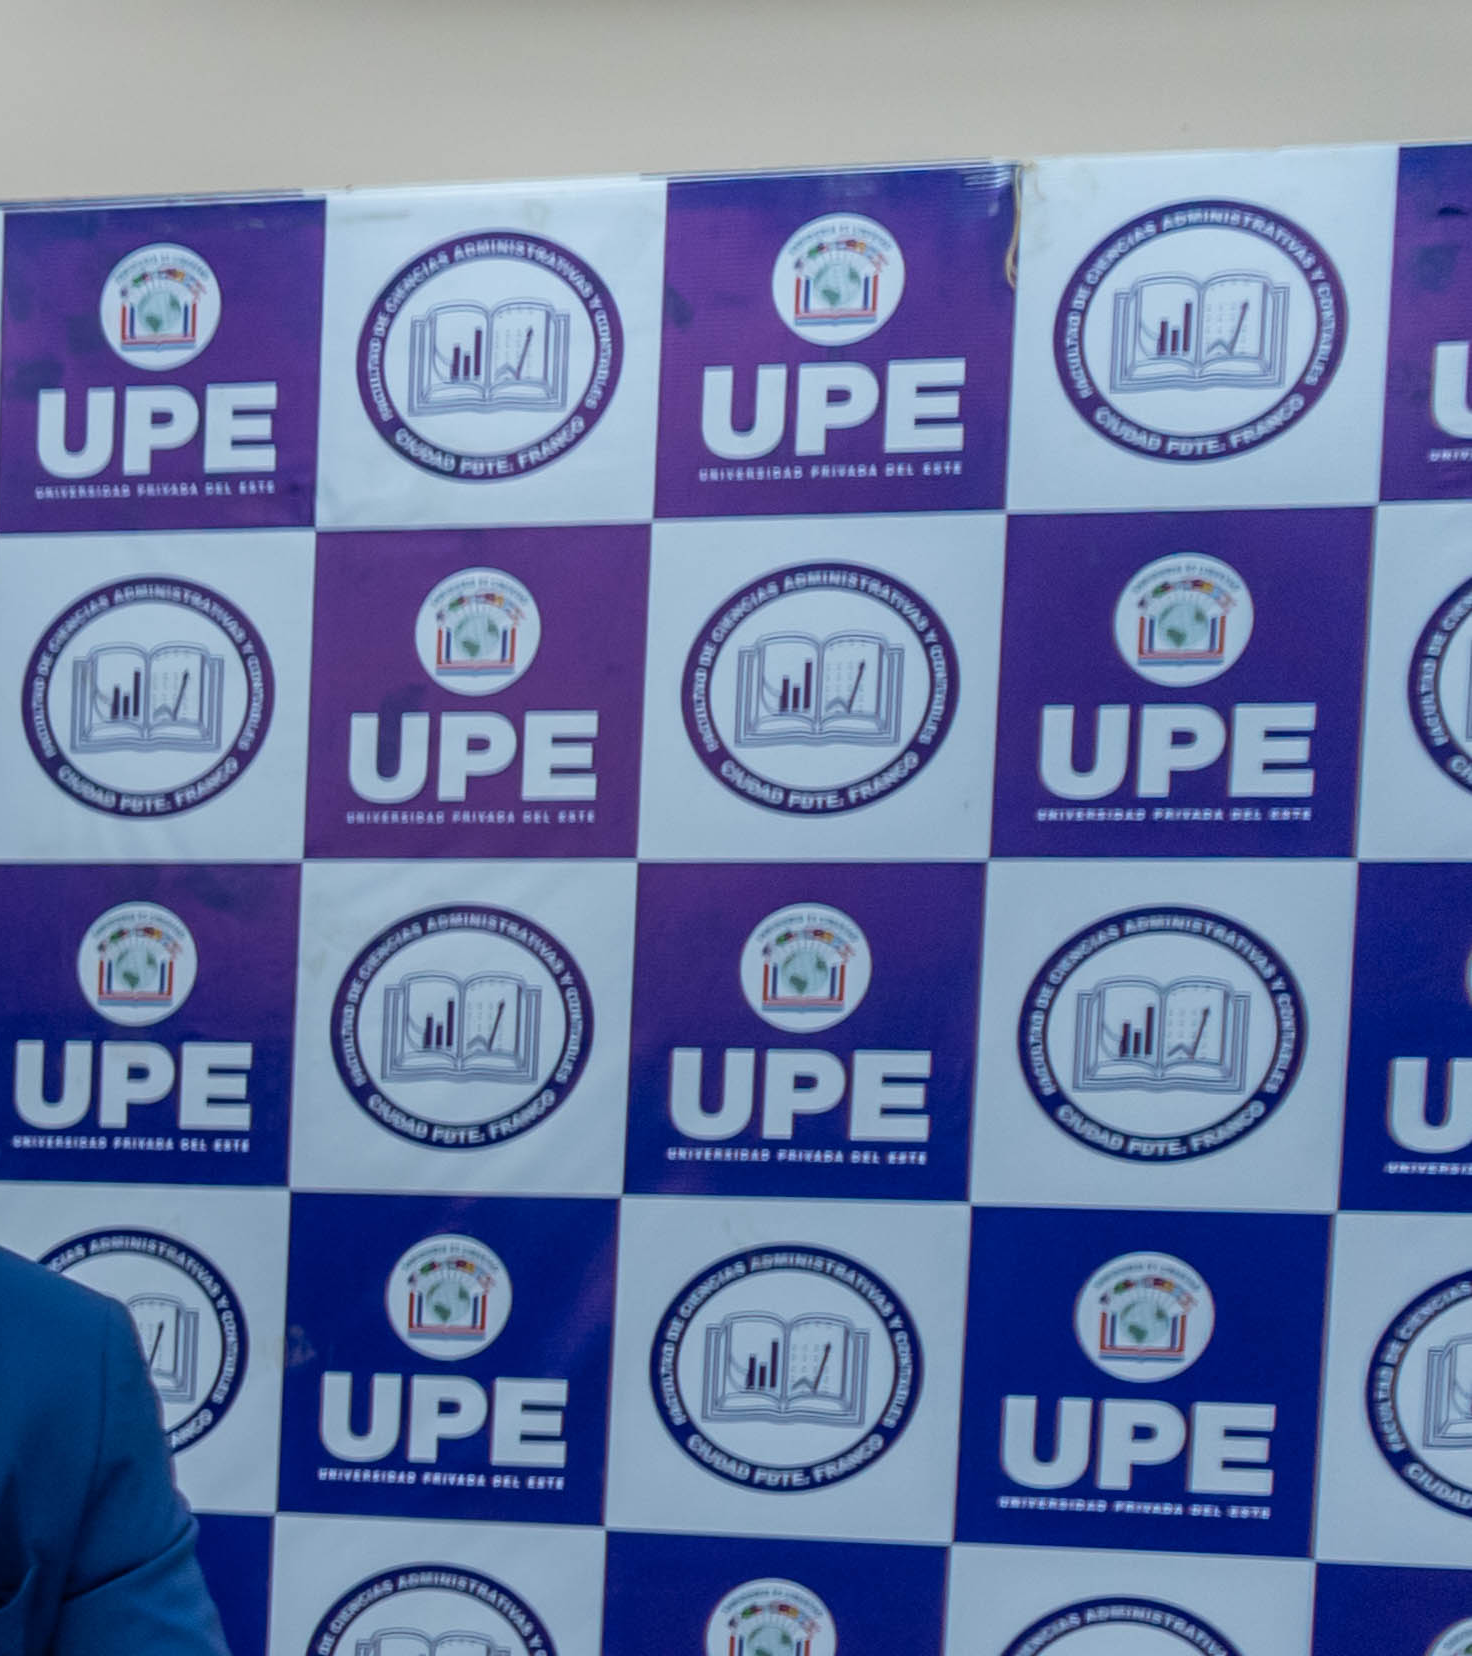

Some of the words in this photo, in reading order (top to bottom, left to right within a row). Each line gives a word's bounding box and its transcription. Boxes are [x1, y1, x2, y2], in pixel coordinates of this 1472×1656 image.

[384, 252, 449, 312] CIENCIAS
[452, 240, 595, 296] ADMINISTRATIVAS
[1072, 285, 1091, 308] DE
[1084, 221, 1156, 284] CIENCIAS
[1160, 208, 1317, 268] ADMINISTRATIVAS
[37, 383, 277, 478] UPE
[701, 358, 965, 459] UPE
[1092, 404, 1162, 450] CIUDAD
[1229, 392, 1305, 446] FRANCO
[393, 426, 456, 470] CIUDAD
[517, 414, 585, 466] FRANCO
[699, 466, 803, 481] UNIVERSIDAD
[811, 464, 878, 478] PRIVADA
[885, 463, 914, 476] DEL
[921, 462, 961, 475] ESTE
[35, 485, 131, 499] UNIVERSIDAD
[138, 483, 199, 496] PRIVADA
[205, 482, 231, 495] DEL
[238, 481, 274, 494] ESTE
[47, 595, 109, 652] CIENCIAS
[112, 585, 247, 642] ADMINISTRATIVAS
[710, 582, 778, 641] CIENCIAS
[782, 571, 930, 630] ADMINISTRATIVAS
[56, 763, 116, 806] CIUDAD
[174, 756, 239, 805] FRANCO
[349, 711, 598, 803] UPE
[718, 758, 784, 803] CIUDAD
[848, 750, 919, 801] FRANCO
[1040, 703, 1316, 799] UPE
[346, 811, 445, 823] UNIVERSIDAD
[452, 811, 516, 823] PRIVADA
[522, 811, 550, 822] DEL
[557, 811, 595, 822] ESTE
[1036, 809, 1146, 821] UNIVERSIDAD
[1154, 808, 1224, 821] PRIVADA
[1231, 808, 1261, 820] DEL
[1269, 808, 1311, 820] ESTE
[358, 923, 422, 979] CIENCIAS
[425, 913, 566, 972] ADMINISTRATIVAS
[1036, 984, 1055, 1007] DE
[1048, 925, 1119, 984] CIENCIAS
[1123, 915, 1277, 978] ADMINISTRATIVAS
[15, 1040, 252, 1129] UPE
[366, 1092, 428, 1137] CIUDAD
[488, 1088, 556, 1136] FRANCO
[670, 1047, 931, 1141] UPE
[13, 1136, 107, 1149] UNIVERSIDAD
[114, 1138, 174, 1150] PRIVADA
[180, 1139, 206, 1150] DEL
[213, 1139, 249, 1151] ESTE
[1055, 1102, 1124, 1149] CIUDAD
[1190, 1099, 1265, 1149] FRANCO
[667, 1148, 770, 1161] UNIVERSIDAD
[778, 1150, 844, 1163] PRIVADA
[851, 1151, 880, 1163] DEL
[887, 1152, 927, 1164] ESTE
[1386, 1162, 1472, 1176] UNIVERSI
[88, 1236, 221, 1296] ADMINISTRATIVAS
[666, 1318, 684, 1340] DE
[678, 1261, 745, 1317] CIENCIAS
[749, 1253, 895, 1315] ADMINISTRATIVAS
[1384, 1340, 1404, 1363] DE
[1397, 1281, 1472, 1339] CIENCIAS
[321, 1371, 568, 1467] UPE
[1002, 1394, 1275, 1495] UPE
[318, 1469, 416, 1484] UNIVERSIDAD
[423, 1473, 486, 1486] PRIVADA
[492, 1475, 520, 1488] DEL
[526, 1477, 564, 1489] ESTE
[686, 1432, 750, 1478] CIUDAD
[813, 1432, 883, 1480] FRANCO
[1404, 1460, 1472, 1509] CIUDAD
[998, 1496, 1107, 1512] UNIVERSIDAD
[1115, 1501, 1184, 1515] PRIVADA
[1191, 1504, 1221, 1517] DEL
[1228, 1505, 1270, 1519] ESTE
[329, 1580, 392, 1633] CIENCIAS
[396, 1572, 534, 1634] ADMINISTRATIVAS
